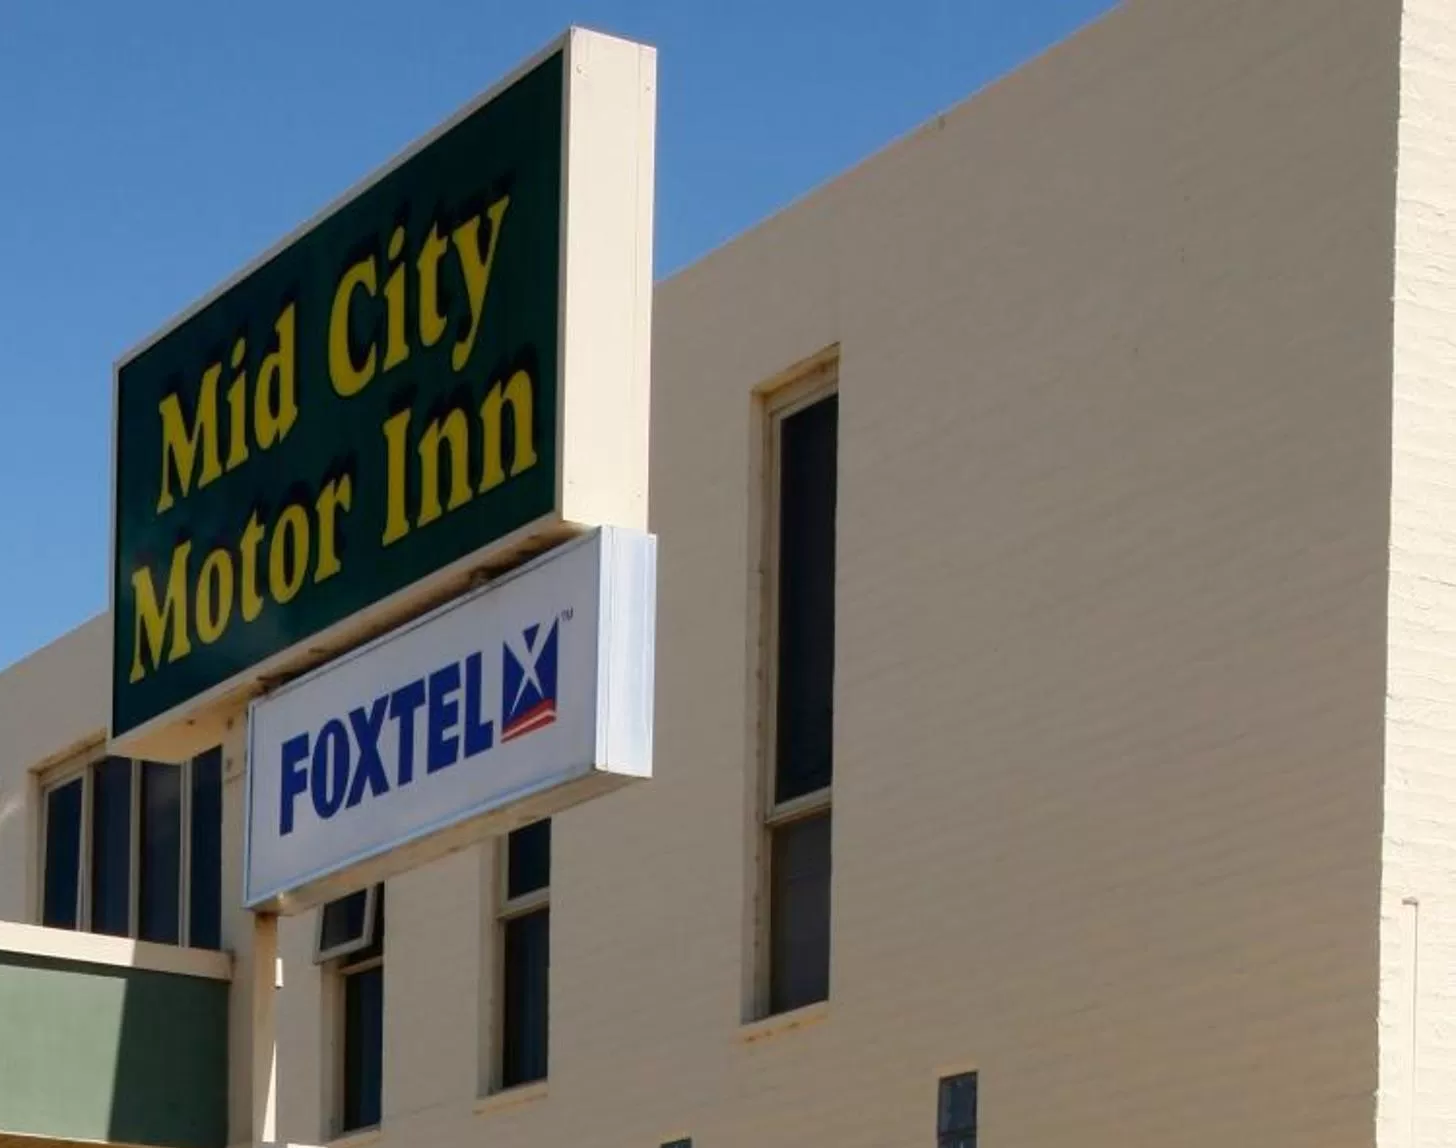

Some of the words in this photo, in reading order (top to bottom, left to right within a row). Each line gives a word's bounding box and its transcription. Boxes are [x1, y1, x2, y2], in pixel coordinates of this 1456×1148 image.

[157, 301, 298, 513] Mid
[329, 195, 510, 396] City
[129, 473, 351, 683] Motor
[382, 368, 537, 546] Inn
[280, 652, 493, 837] FOXTEL
